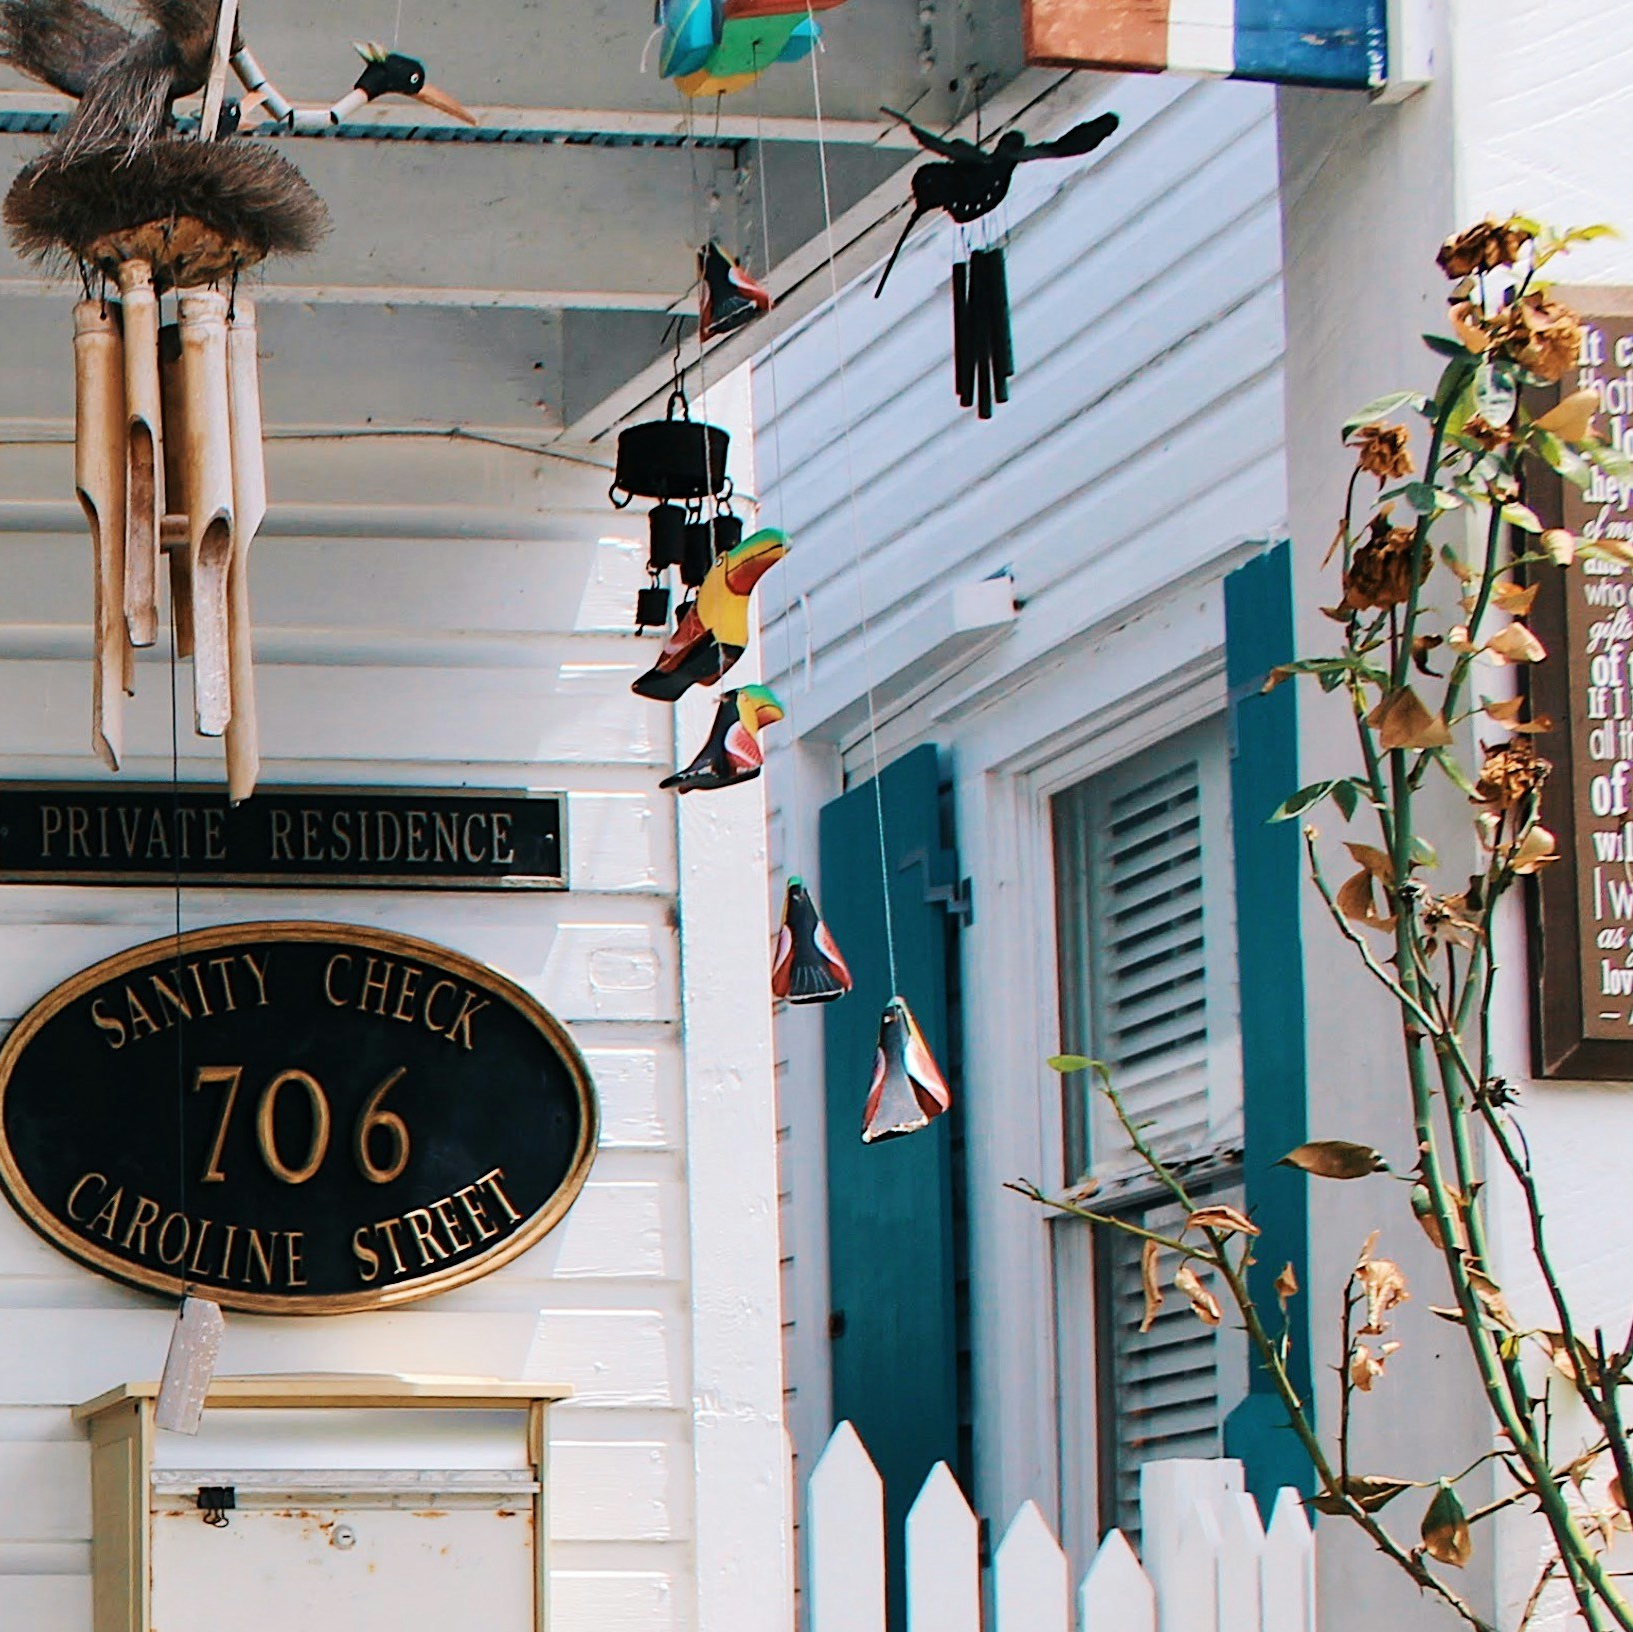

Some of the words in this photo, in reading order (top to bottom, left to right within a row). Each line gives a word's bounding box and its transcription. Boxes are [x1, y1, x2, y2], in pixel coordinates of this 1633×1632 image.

[1577, 325, 1605, 367] It
[1583, 577, 1626, 608] who
[1590, 642, 1624, 687] of
[1587, 686, 1610, 719] If
[1612, 686, 1626, 719] I
[1588, 718, 1616, 760] all
[1590, 760, 1630, 816] of
[39, 805, 227, 861] PRIVATE
[269, 809, 515, 864] RESIDENCE
[1593, 866, 1603, 920] I
[1596, 926, 1627, 949] as
[91, 952, 273, 1050] SANITY
[324, 952, 491, 1051] CHECK
[192, 1065, 412, 1184] 706
[66, 1171, 308, 1287] CAROLINE
[352, 1166, 524, 1282] STREET
